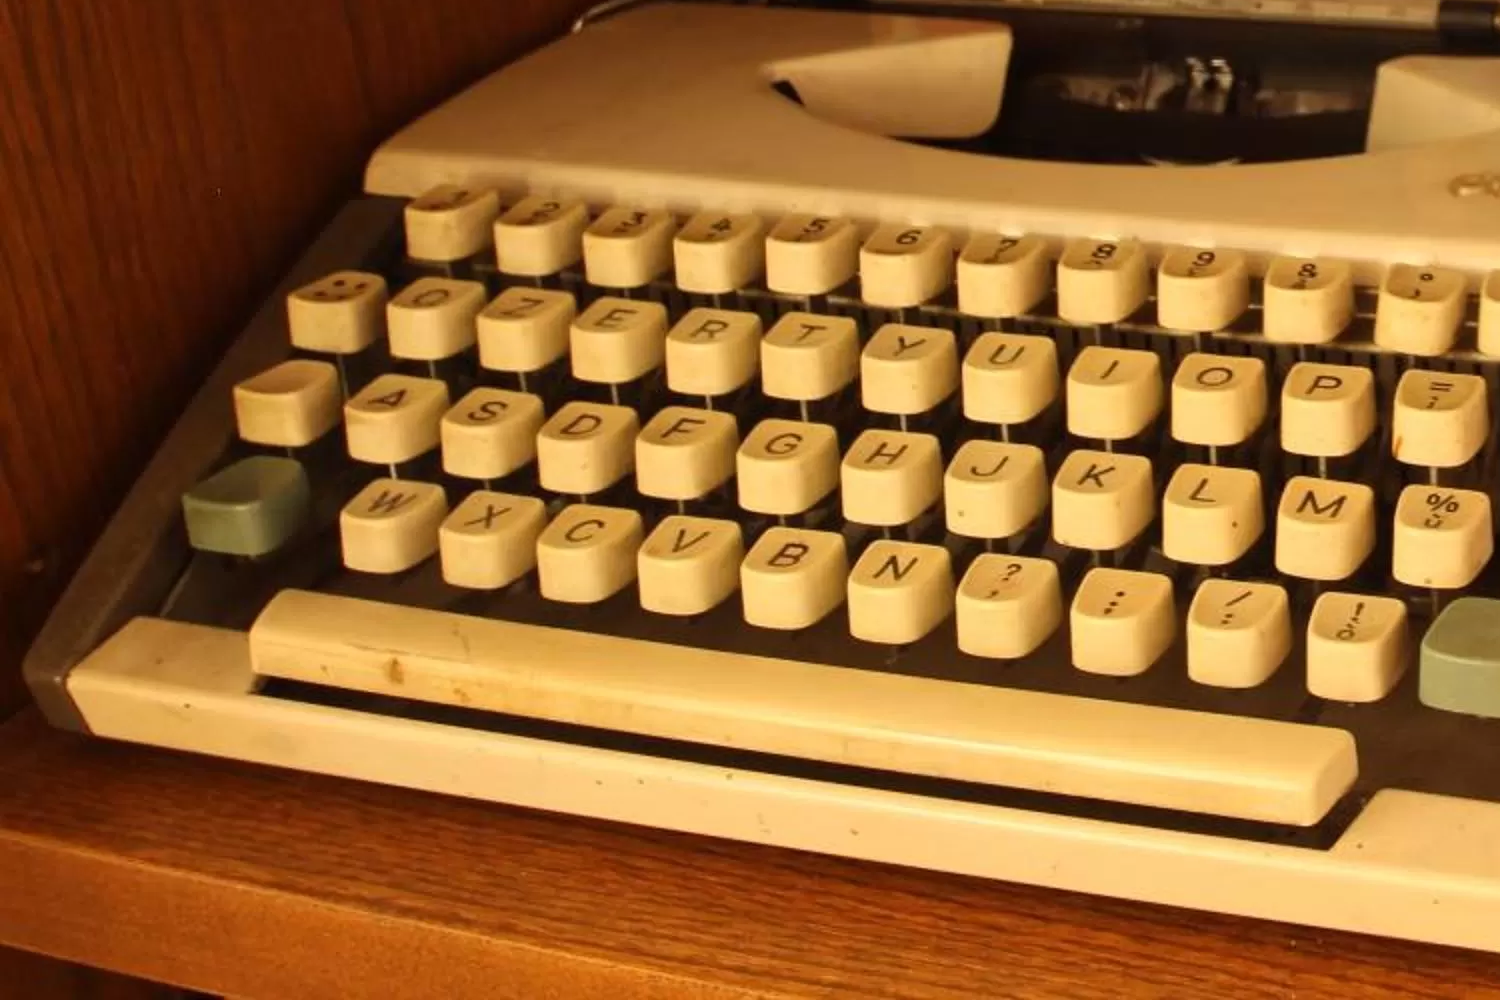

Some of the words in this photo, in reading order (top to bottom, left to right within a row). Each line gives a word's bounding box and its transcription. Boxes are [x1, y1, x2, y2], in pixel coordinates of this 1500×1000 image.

[803, 218, 831, 233] 5
[896, 229, 922, 245] 6
[1092, 243, 1117, 260] 8
[1192, 251, 1215, 267] 9
[594, 308, 637, 329] E
[694, 320, 736, 342] R
[797, 323, 833, 343] T
[893, 335, 927, 357] Y
[989, 344, 1027, 365] U
[1195, 366, 1234, 387] O
[1306, 375, 1343, 396] P
[368, 389, 407, 407] A
[467, 401, 509, 422] S
[560, 414, 603, 435] D
[662, 417, 706, 440] F
[764, 432, 804, 456] G
[864, 442, 908, 465] H
[970, 455, 1010, 478] J
[1077, 464, 1117, 490] K
[1189, 478, 1216, 503] L
[1295, 490, 1347, 519] M
[367, 490, 418, 513] W
[463, 503, 511, 530] X
[563, 518, 605, 543] C
[672, 528, 710, 554] V
[765, 543, 808, 568] B
[871, 553, 919, 582] N
